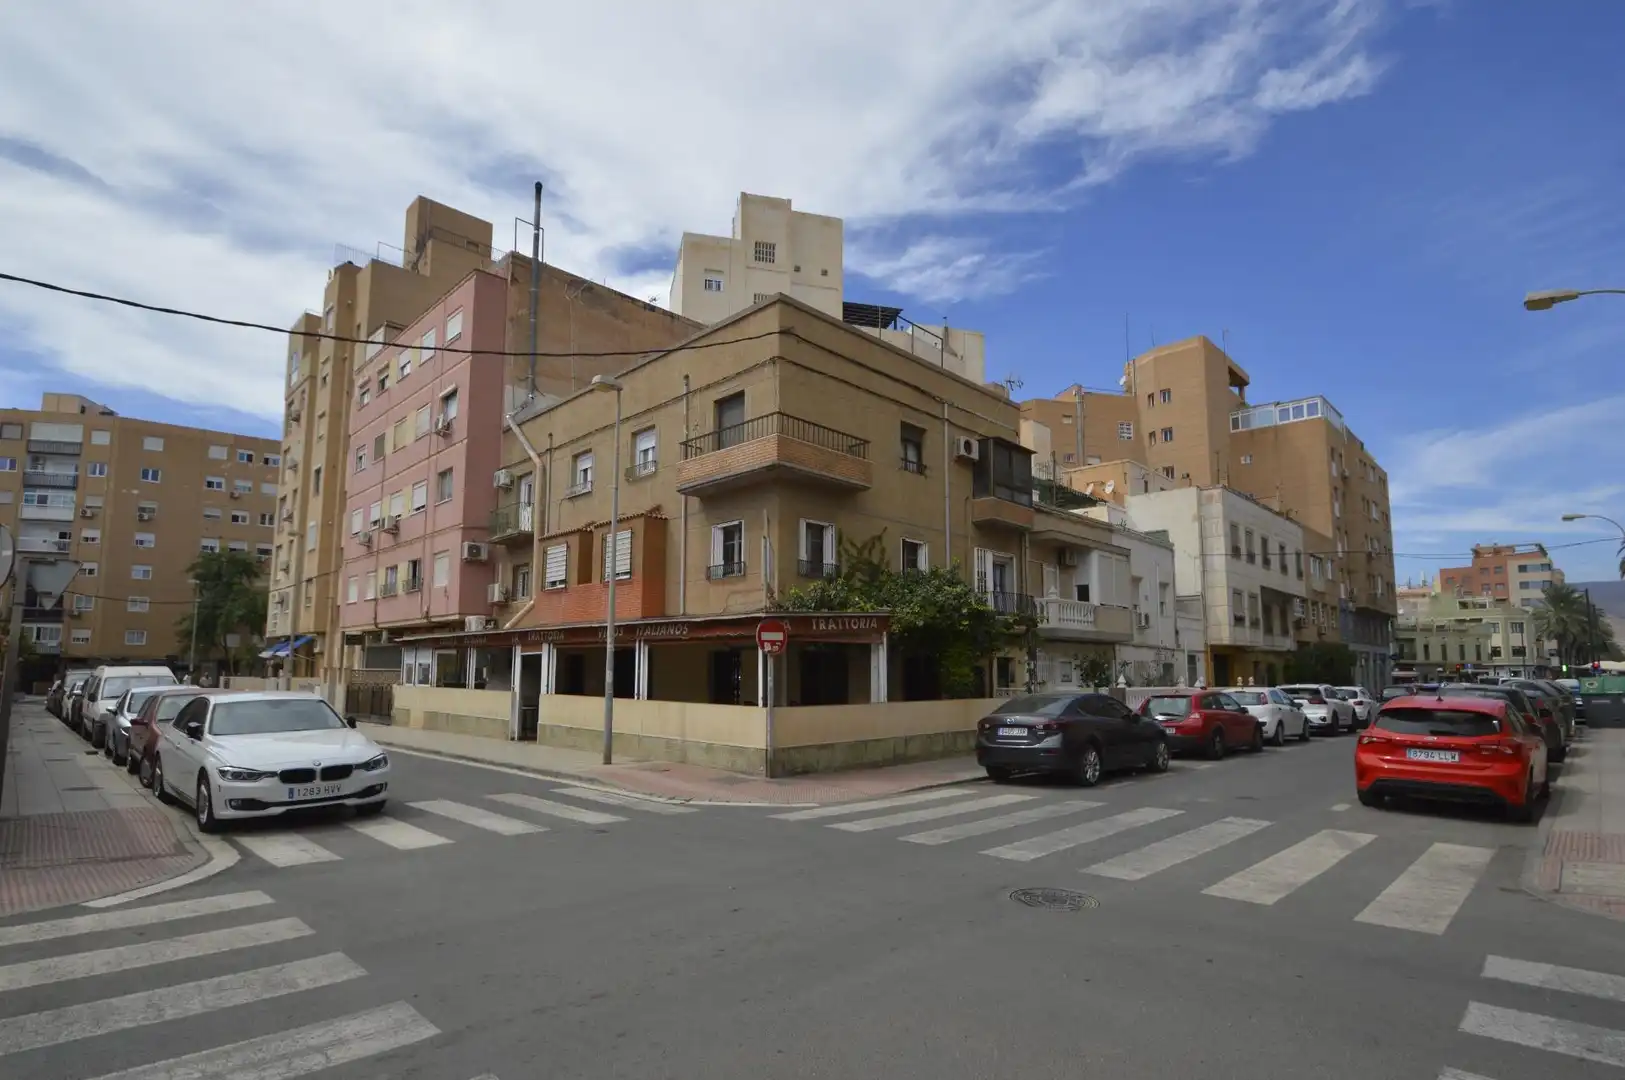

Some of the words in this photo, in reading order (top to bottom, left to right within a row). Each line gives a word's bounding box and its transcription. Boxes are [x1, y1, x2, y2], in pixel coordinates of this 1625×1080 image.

[811, 618, 878, 630] TRATTORIA
[528, 630, 565, 641] TRATTORIA
[598, 626, 624, 639] VIOS
[636, 623, 689, 637] ITALIANOS
[1412, 750, 1435, 759] 8794
